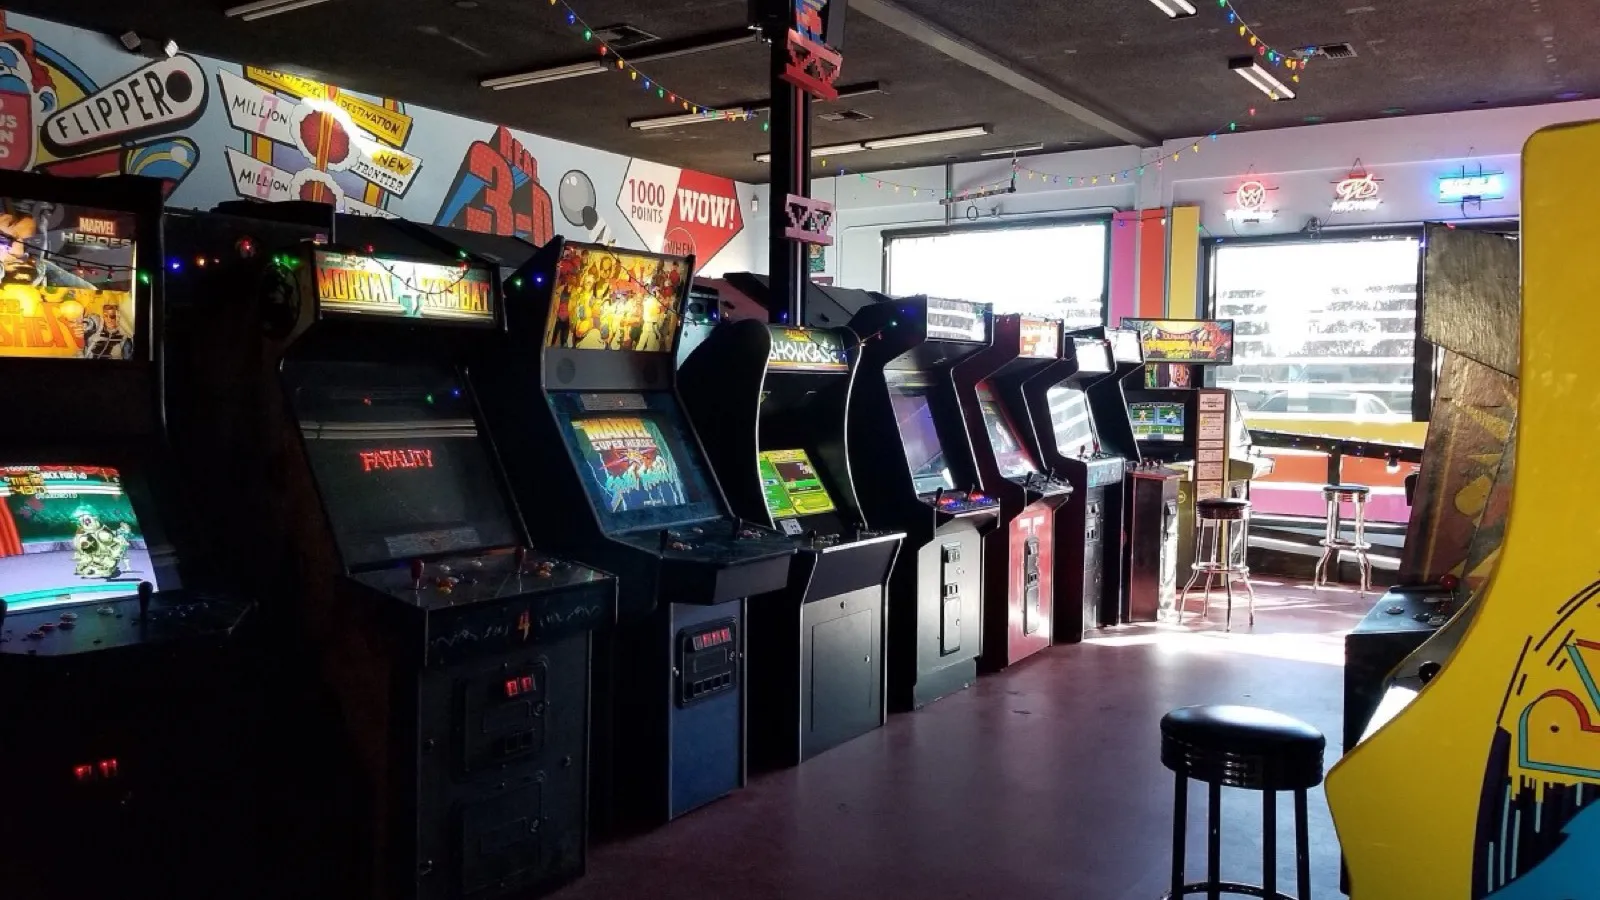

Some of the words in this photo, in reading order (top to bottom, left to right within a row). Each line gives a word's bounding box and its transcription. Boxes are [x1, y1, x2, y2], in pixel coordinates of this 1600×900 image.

[55, 70, 173, 139] FLIPPER
[231, 94, 289, 124] MILLION
[341, 99, 401, 134] DESTINATION
[379, 153, 410, 172] NEW
[238, 168, 289, 192] MILLION
[355, 161, 405, 192] FRONTIER
[628, 178, 666, 208] 1000
[631, 204, 664, 224] POINTS
[676, 187, 736, 231] WOW!
[79, 216, 116, 235] MARVEL
[61, 231, 132, 248] HEROES
[666, 239, 694, 256] WHEN
[319, 269, 396, 303] MORTAL
[420, 276, 490, 312] KOMBAT
[582, 417, 653, 441] MARVEL
[591, 440, 625, 451] SUPER
[625, 438, 656, 449] HEROES
[359, 449, 434, 471] FATALITY
